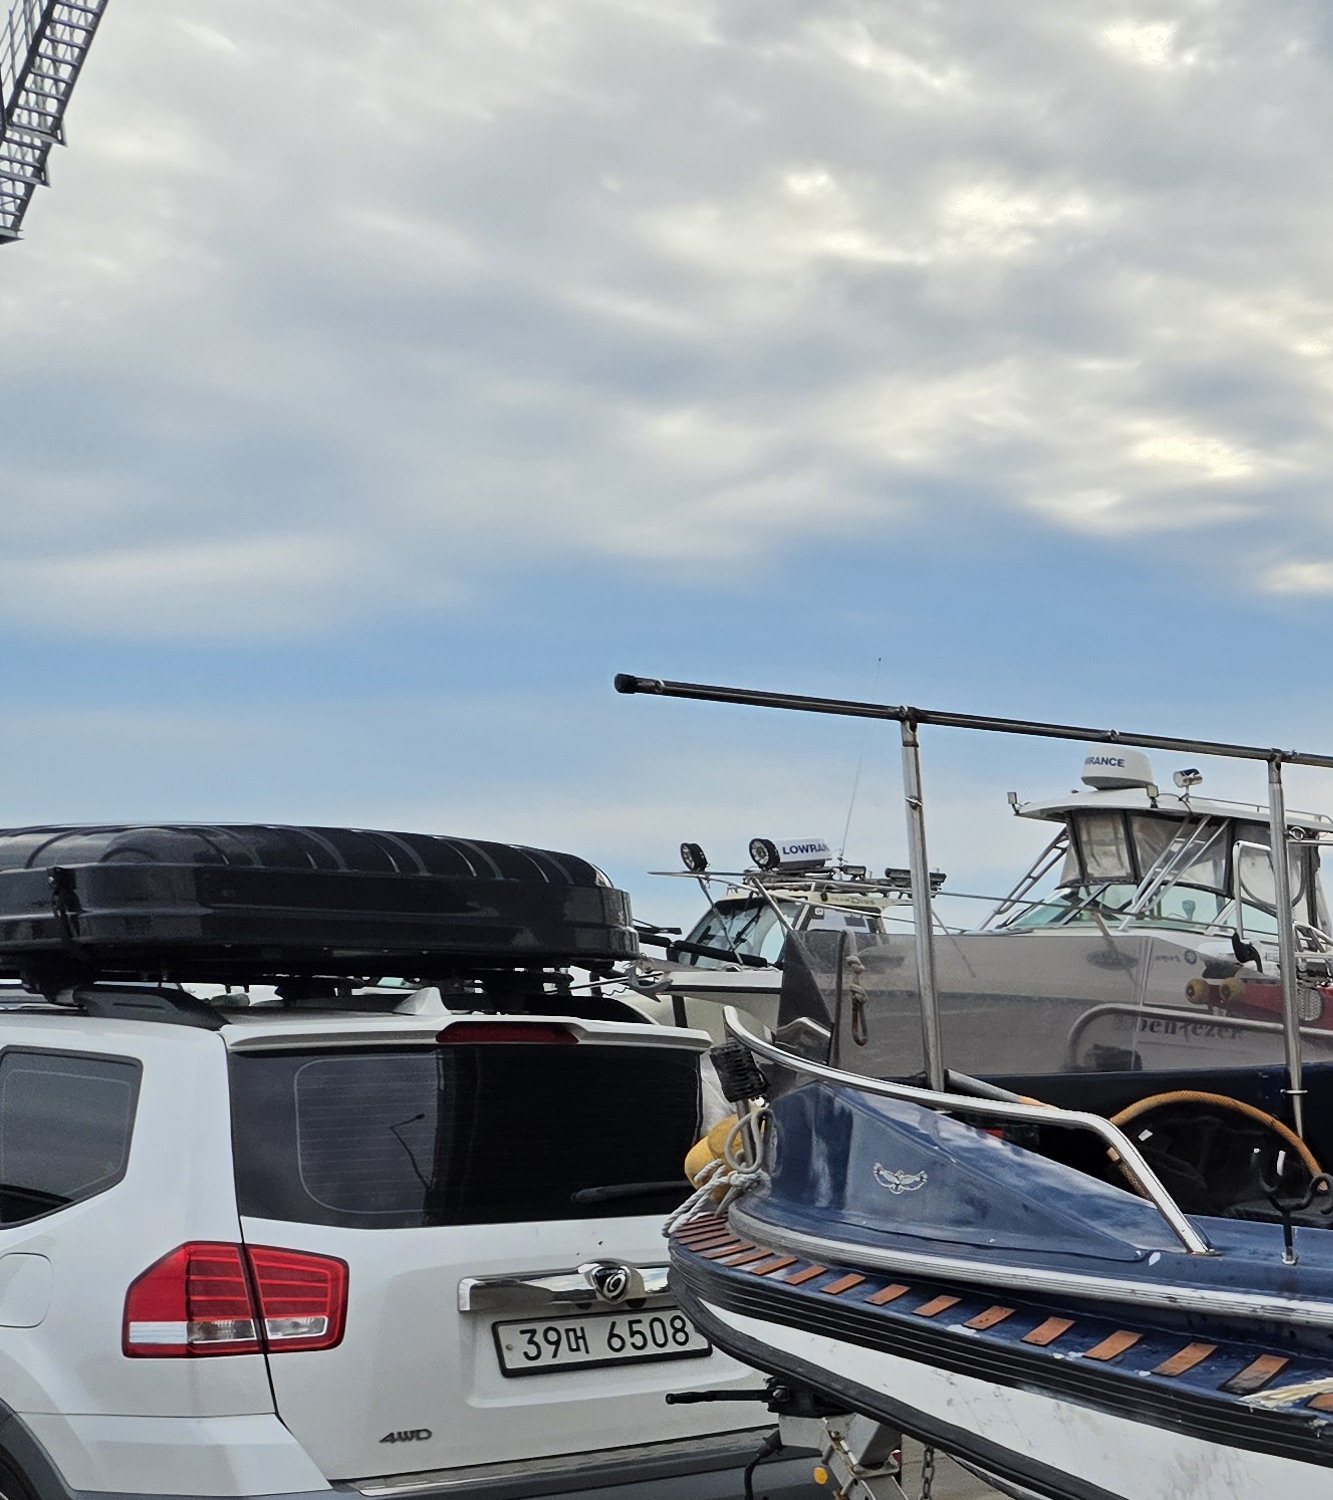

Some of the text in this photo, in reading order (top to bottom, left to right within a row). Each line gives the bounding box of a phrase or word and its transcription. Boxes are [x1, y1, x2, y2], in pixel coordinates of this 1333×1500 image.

[519, 1314, 690, 1361] 39머 6508
[379, 1428, 433, 1444] 4WD
